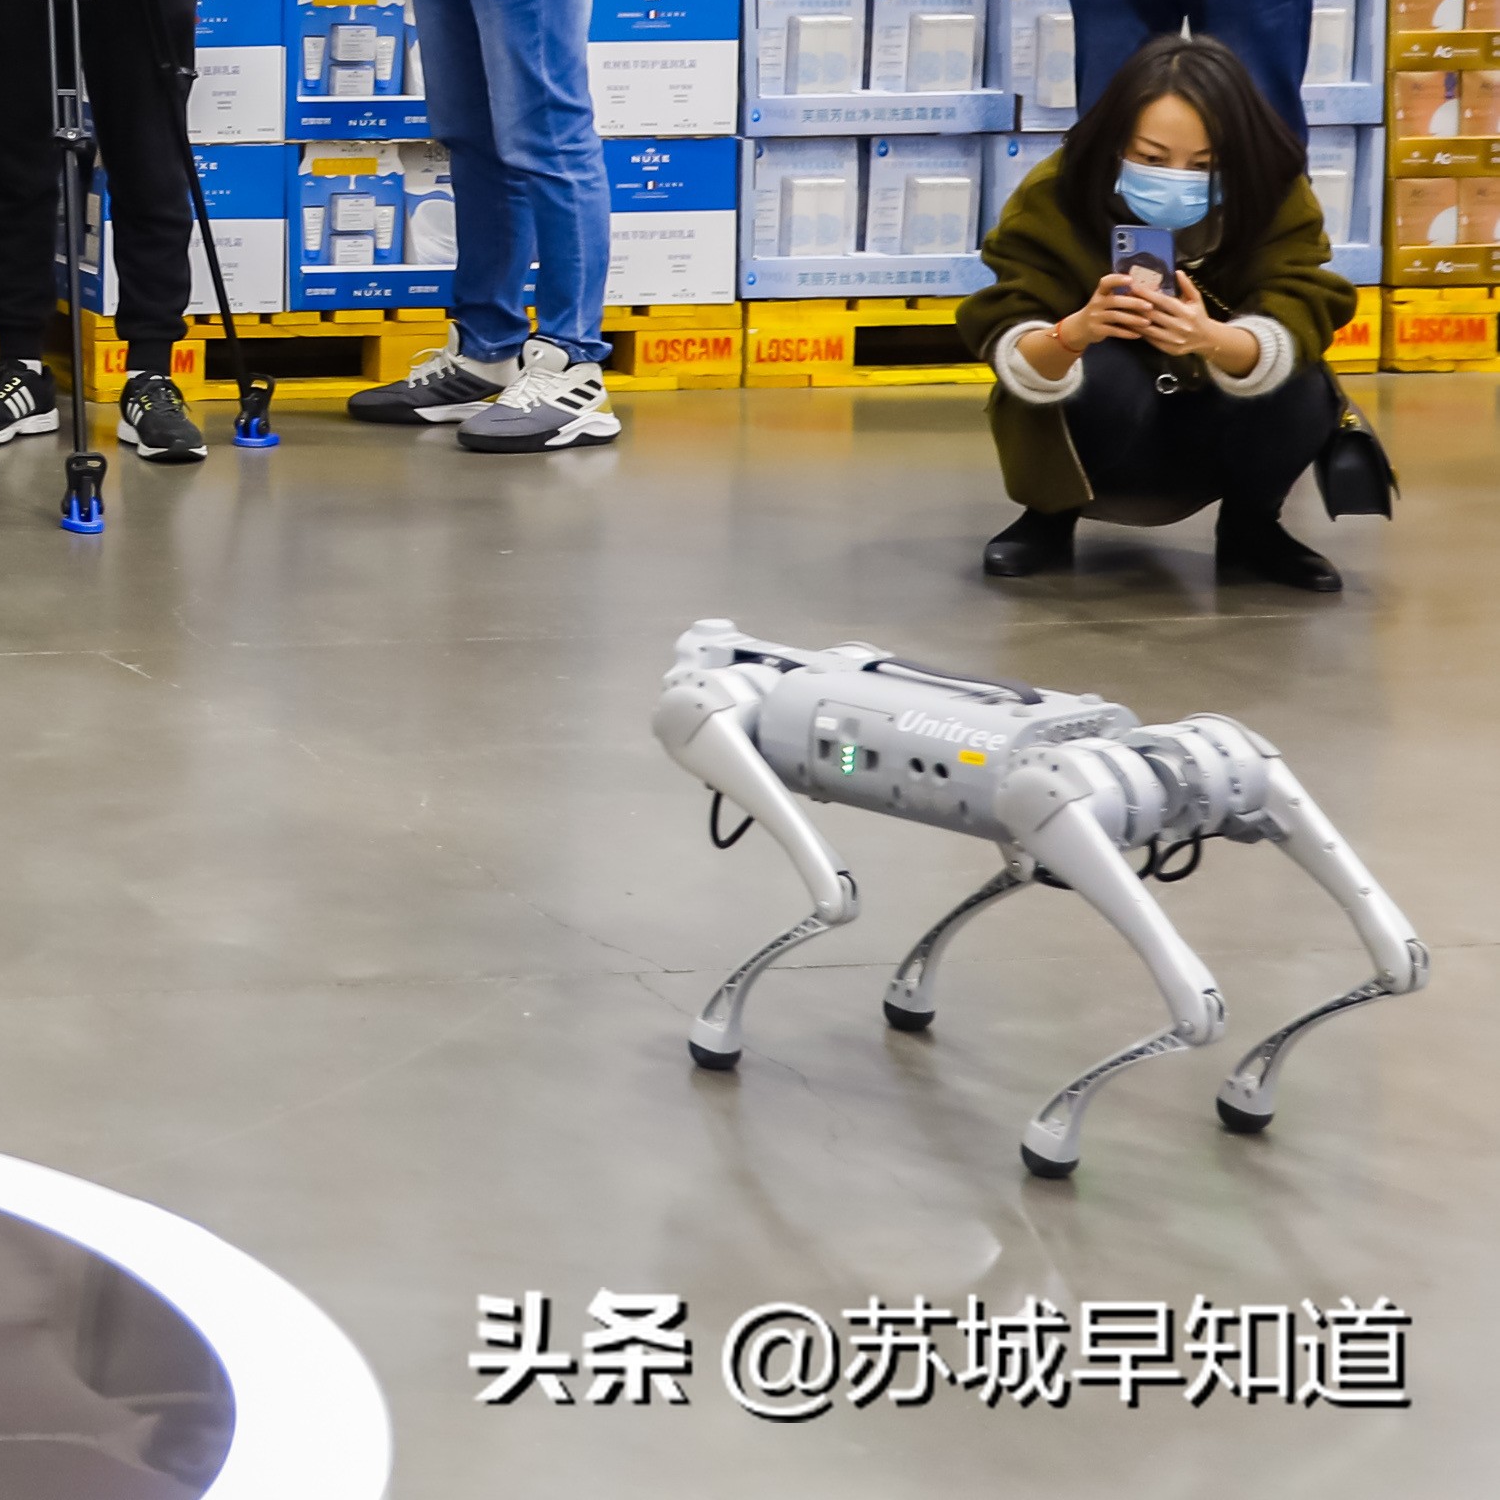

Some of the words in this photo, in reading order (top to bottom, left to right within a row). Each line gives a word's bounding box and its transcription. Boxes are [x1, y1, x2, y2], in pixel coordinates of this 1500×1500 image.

[348, 118, 387, 127] NUXE
[630, 154, 671, 164] NUXE
[352, 288, 393, 298] NUXE
[1398, 318, 1487, 344] LOSCAM
[642, 337, 732, 365] LOSCAM
[755, 336, 844, 363] LOSCAM
[896, 706, 1009, 753] Unitree
